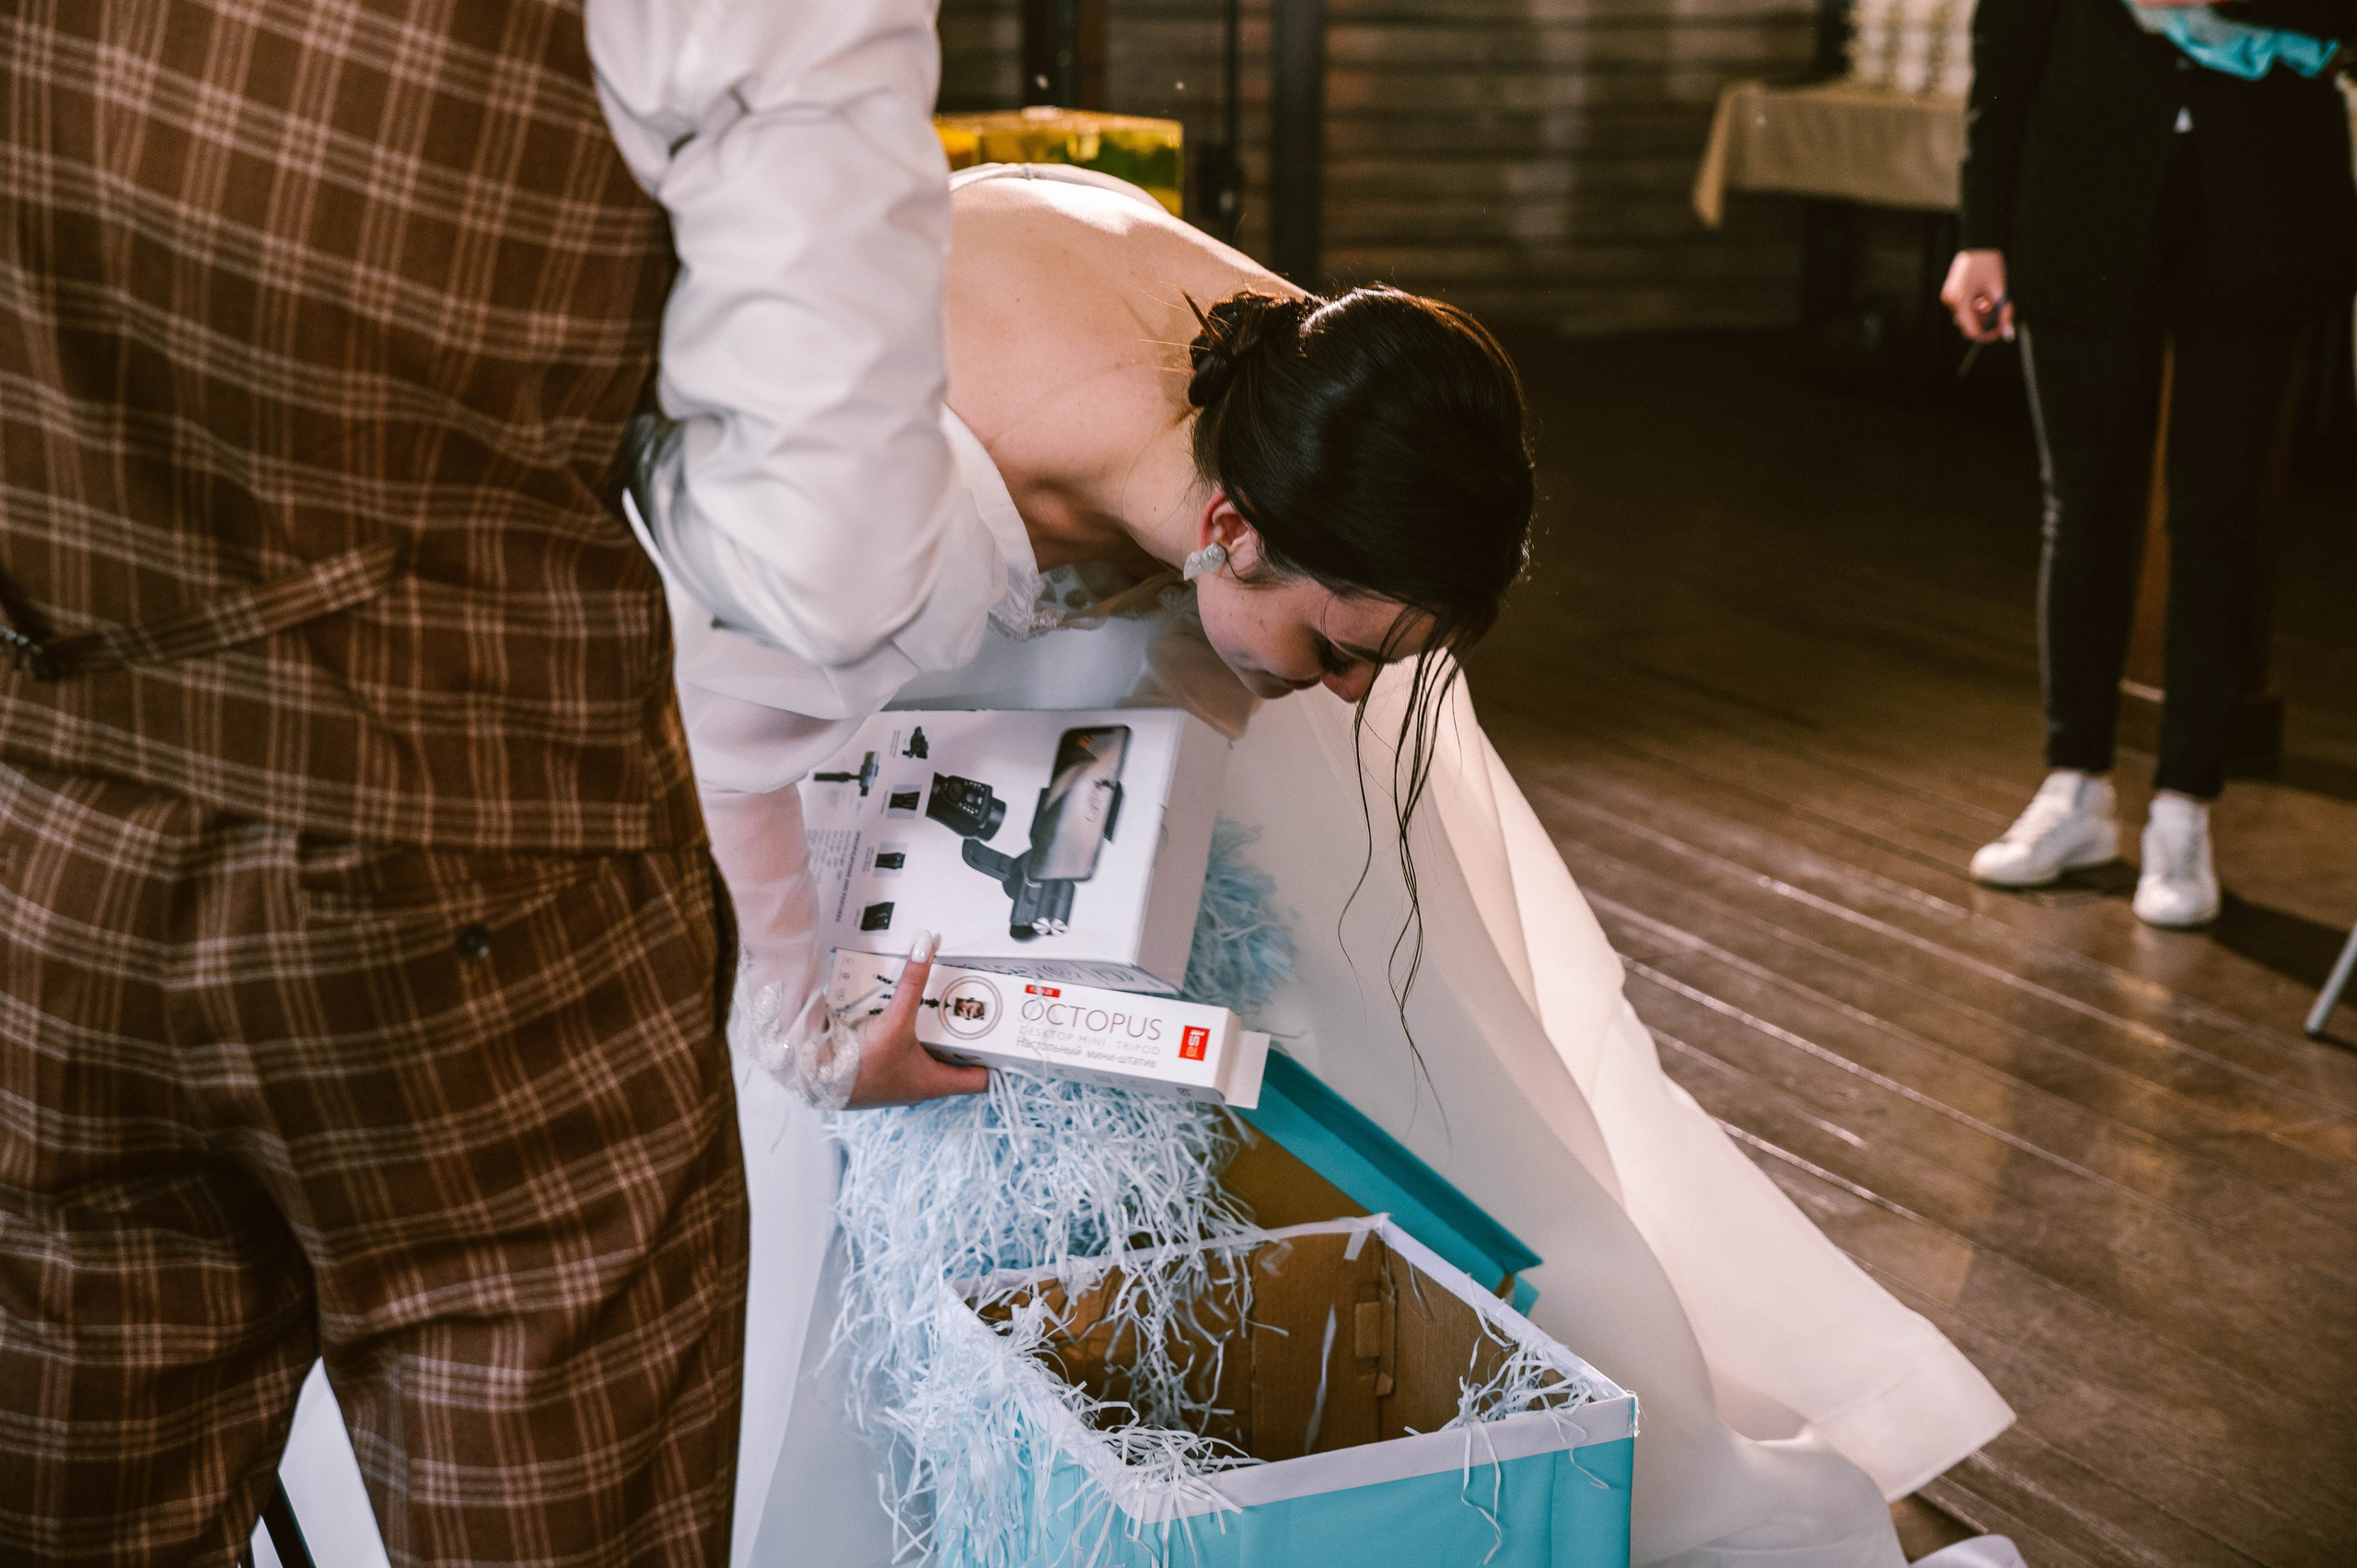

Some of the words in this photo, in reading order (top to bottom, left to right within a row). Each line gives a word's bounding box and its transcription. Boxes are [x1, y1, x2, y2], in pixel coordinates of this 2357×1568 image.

[1021, 999, 1163, 1040] OCTOPUS
[1019, 1027, 1074, 1041] DESKTOP
[1077, 1034, 1107, 1047] MINI
[1116, 1040, 1161, 1055] TRIPOD
